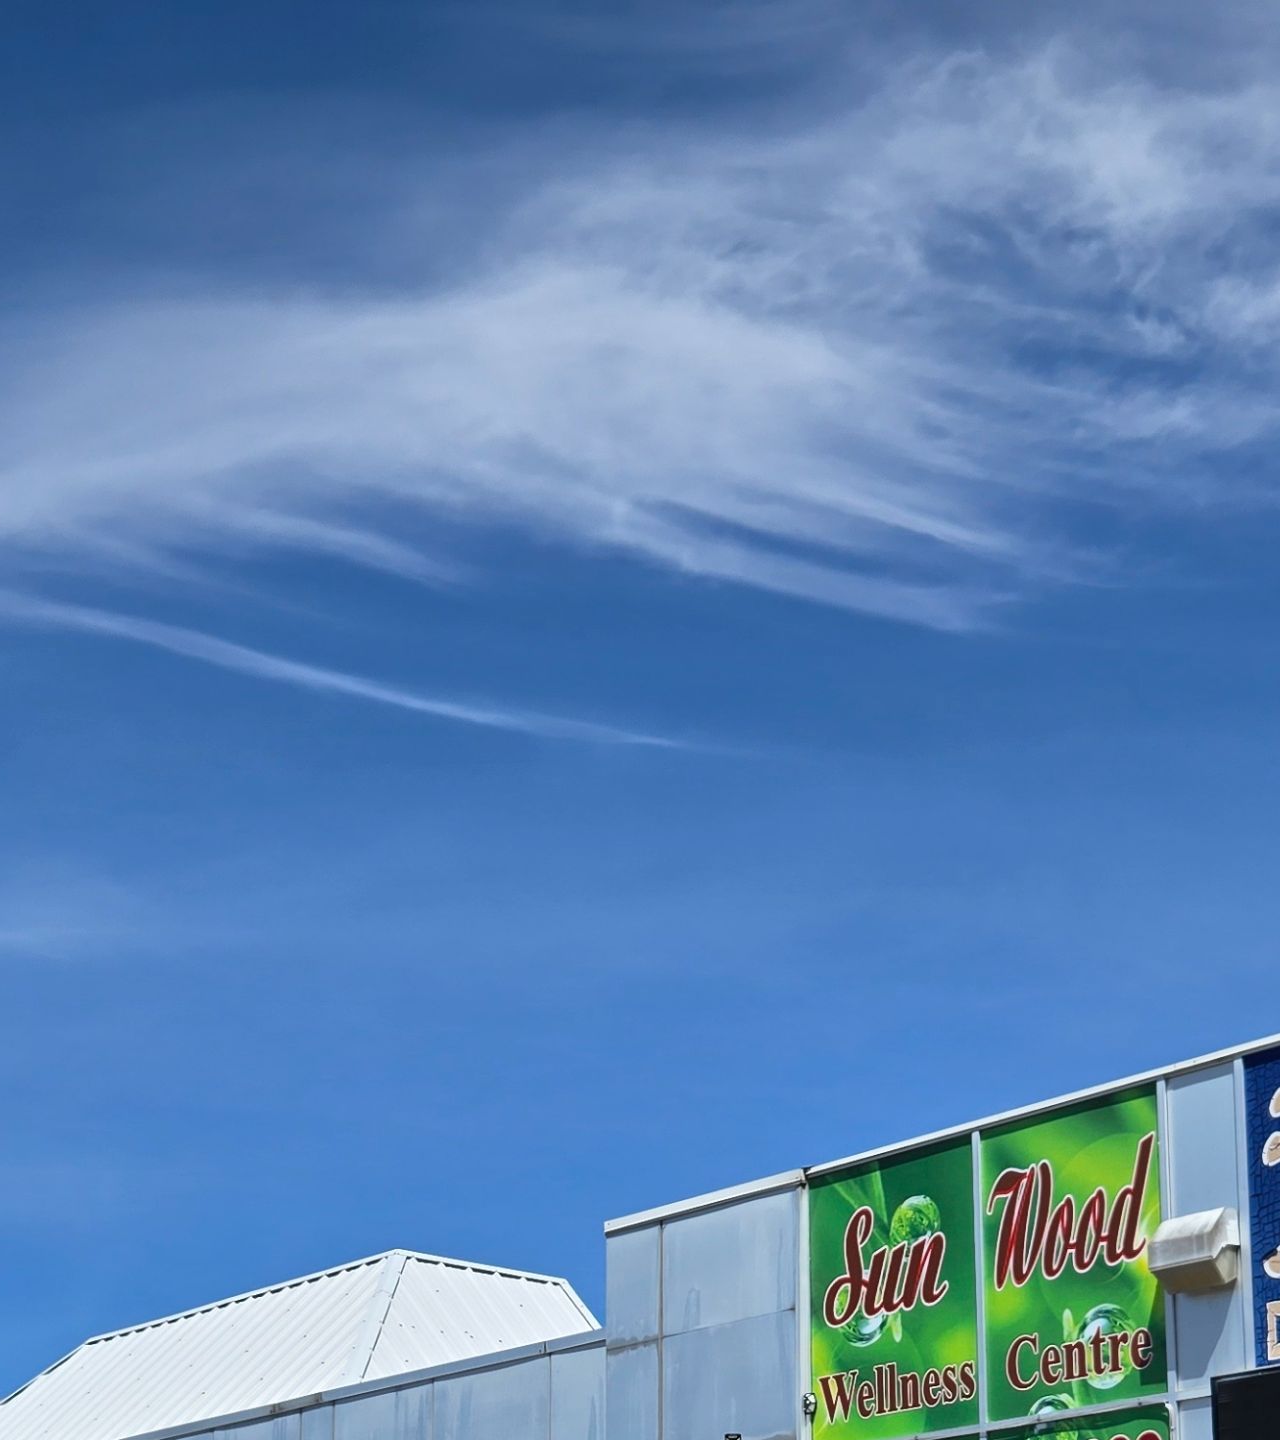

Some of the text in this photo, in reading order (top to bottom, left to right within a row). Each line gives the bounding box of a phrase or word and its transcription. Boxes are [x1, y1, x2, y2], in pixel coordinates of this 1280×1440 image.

[823, 1131, 1157, 1329] Sun Wood
[816, 1326, 1154, 1426] Wellness Centre
